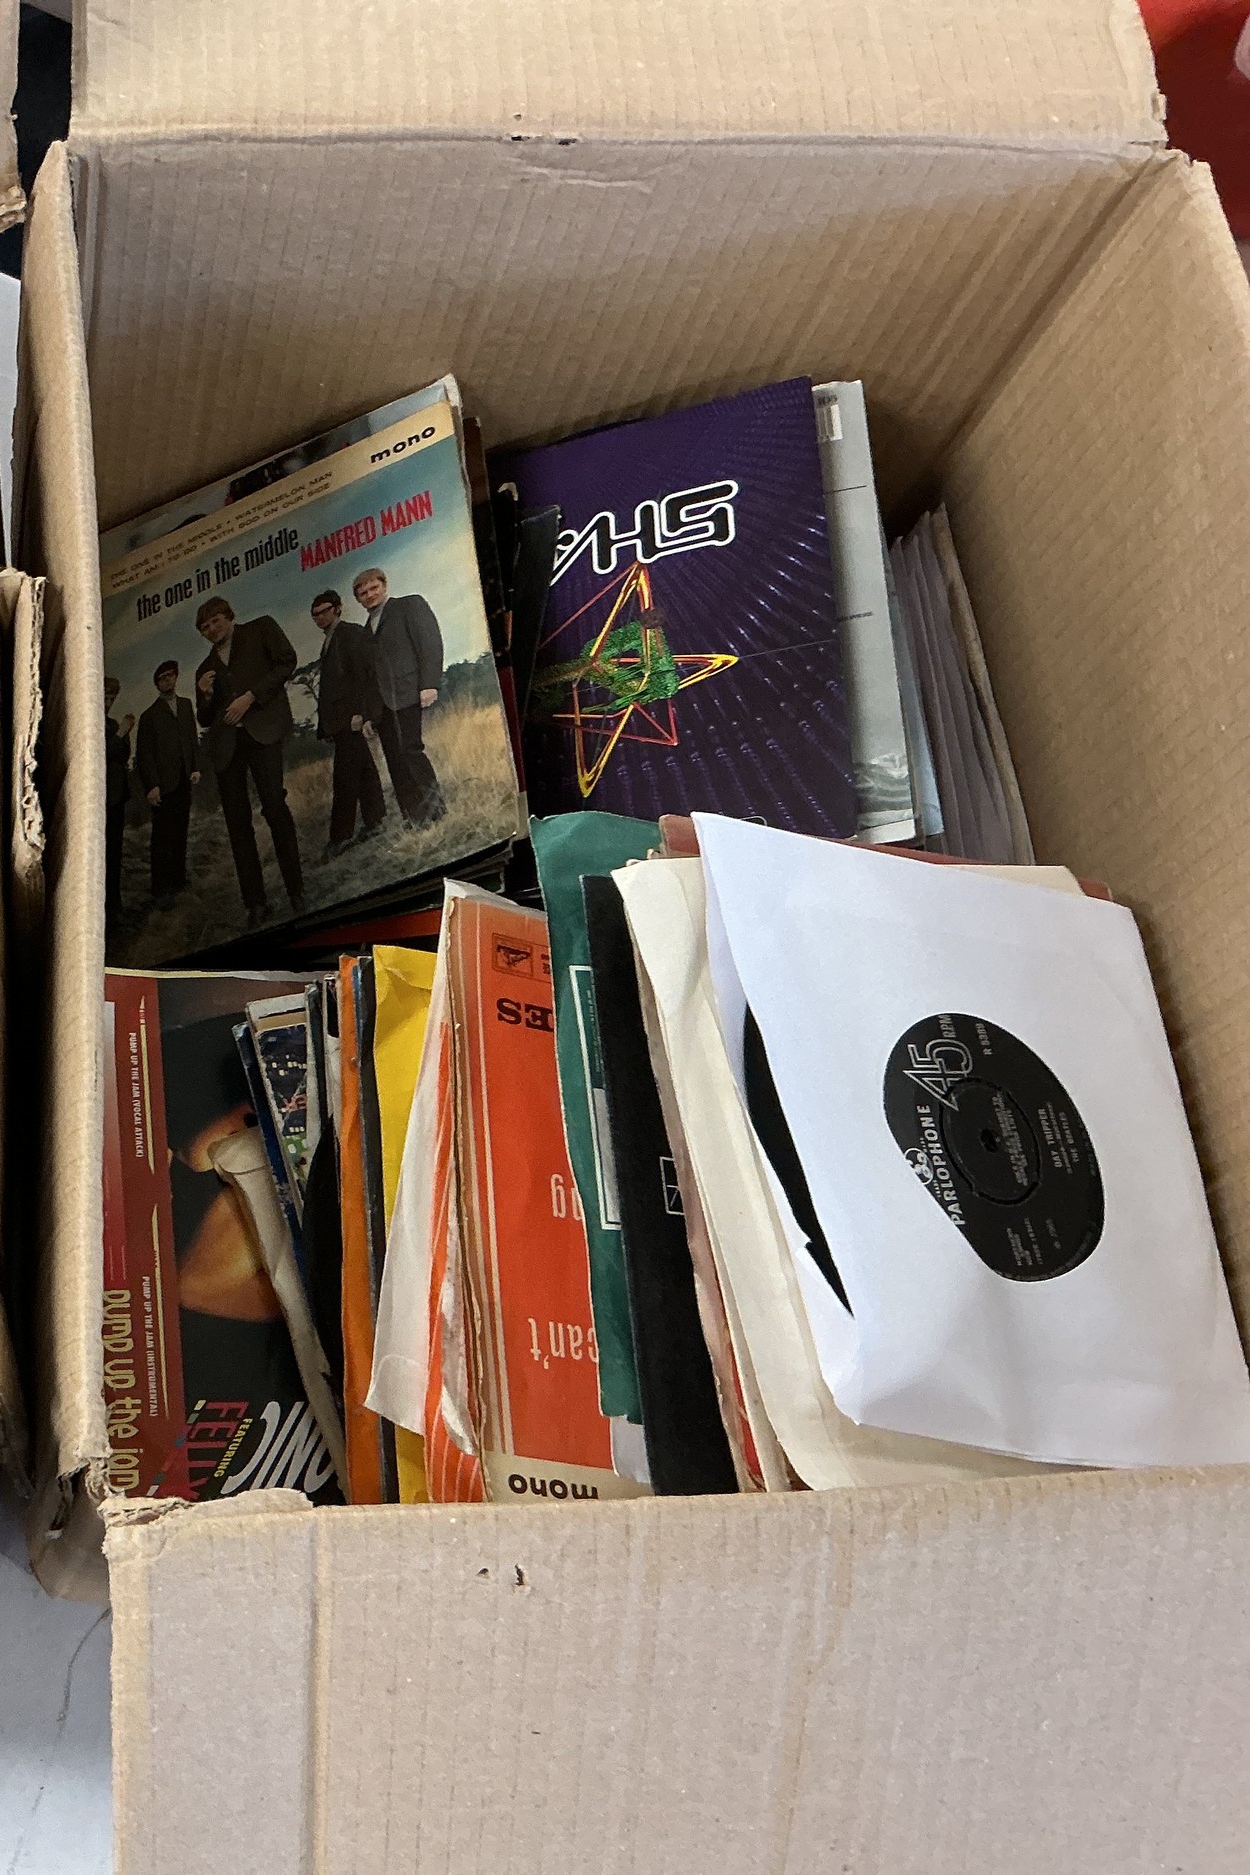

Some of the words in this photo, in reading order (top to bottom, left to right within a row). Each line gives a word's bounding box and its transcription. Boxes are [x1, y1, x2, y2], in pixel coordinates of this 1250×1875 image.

[369, 425, 437, 465] mono
[308, 471, 333, 487] MAN
[300, 514, 378, 573] MANFRED
[380, 489, 436, 537] MANN
[136, 592, 162, 622] the
[164, 578, 194, 608] one
[195, 567, 212, 594] in
[213, 553, 242, 585] the
[244, 526, 301, 573] middle
[128, 1032, 138, 1054] PUMP
[130, 1054, 138, 1064] UP
[130, 1066, 140, 1081] THE
[132, 1082, 140, 1098] JAM
[902, 1038, 974, 1112] 45
[132, 1099, 142, 1126] (VOCAL
[1038, 1108, 1056, 1146] TRIPPER
[134, 1126, 144, 1158] ATTACK)
[916, 1104, 966, 1226] PARLOPHONE
[1050, 1150, 1063, 1168] DAY
[142, 1276, 151, 1300] PUMP
[102, 1289, 134, 1353] pump
[143, 1300, 152, 1313] UP
[144, 1314, 154, 1328] THE
[146, 1330, 156, 1348] JAM
[104, 1358, 136, 1390] up
[146, 1349, 158, 1418] (INSTRUMENTAL)
[107, 1396, 142, 1439] the
[213, 1418, 254, 1478] FEATURING
[507, 1472, 600, 1501] mono
